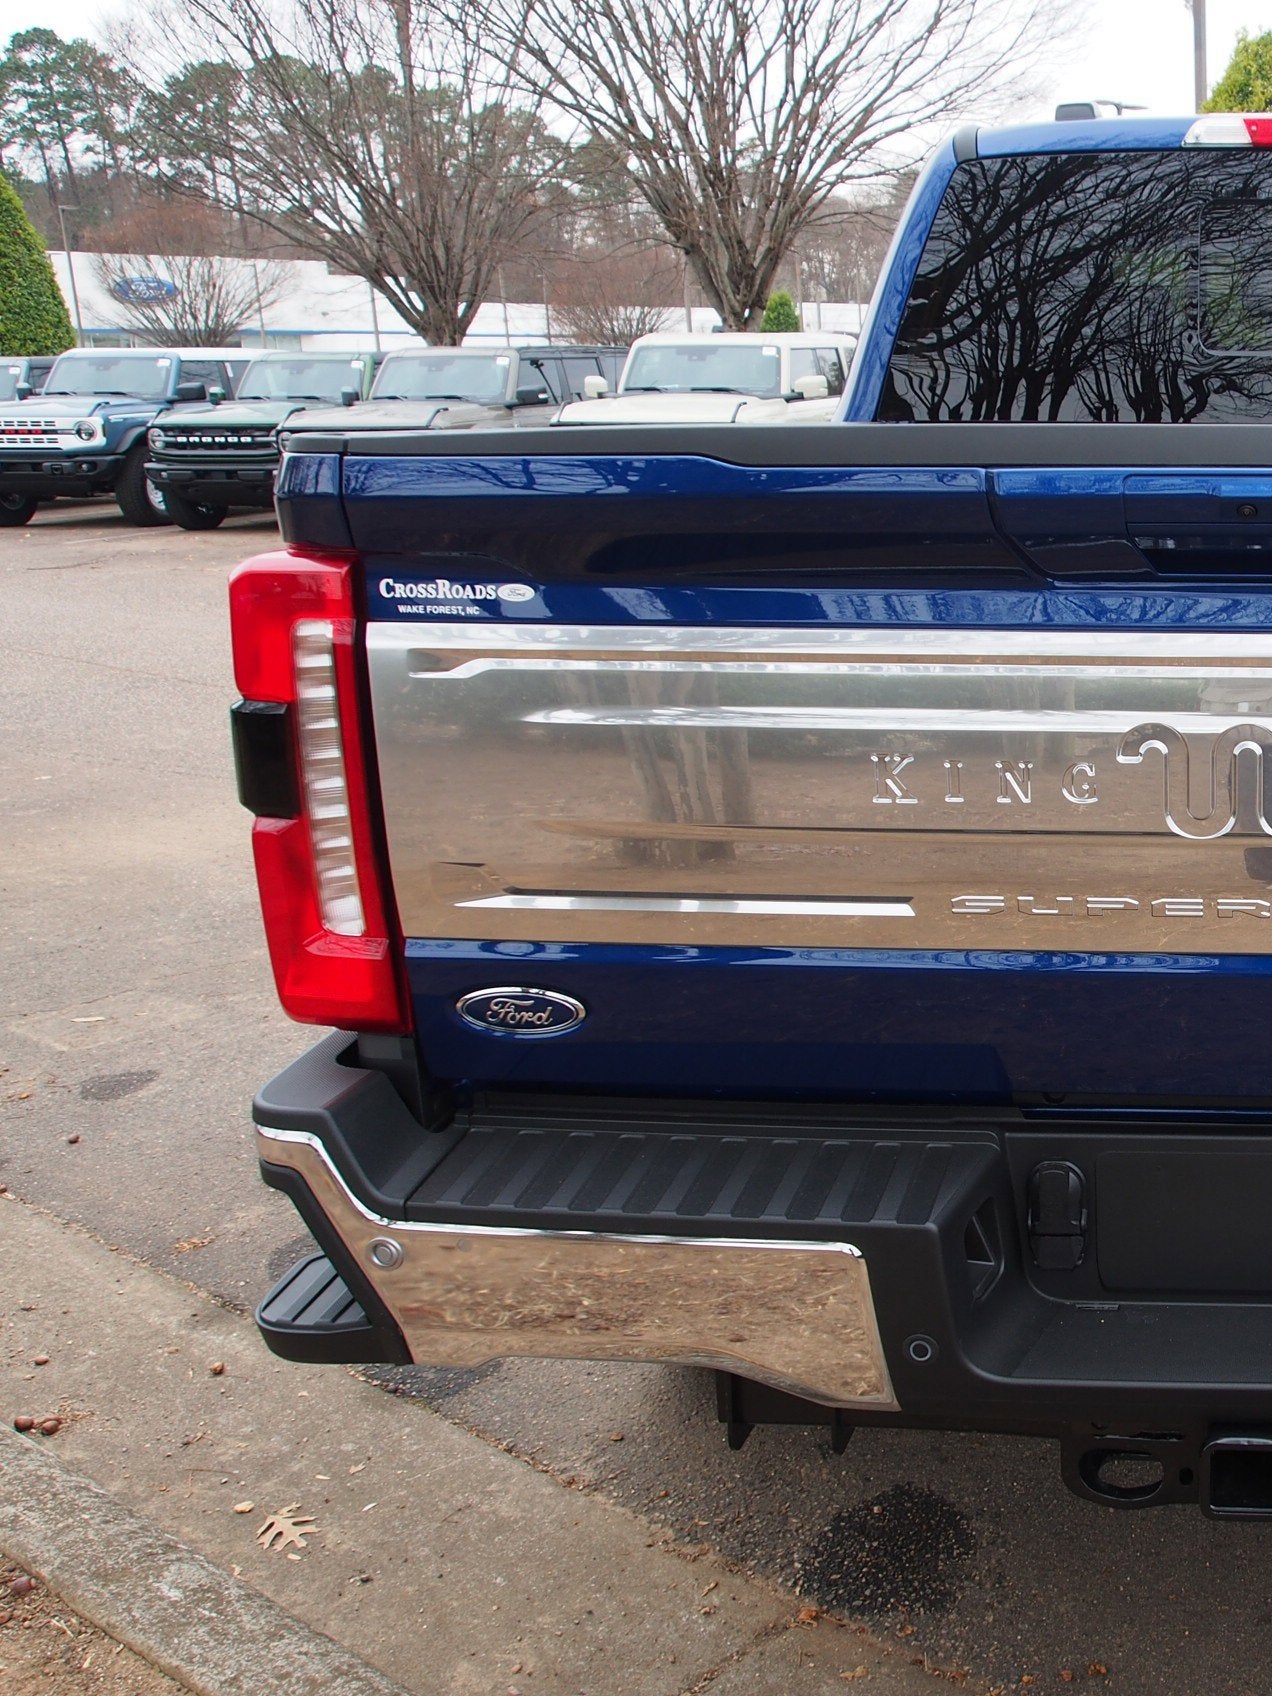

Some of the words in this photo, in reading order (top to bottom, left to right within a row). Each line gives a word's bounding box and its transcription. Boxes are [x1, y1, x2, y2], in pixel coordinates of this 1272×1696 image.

[397, 605, 425, 614] WAKE
[427, 605, 465, 616] FOREST,
[466, 607, 480, 615] NC
[870, 753, 1099, 804] KING
[951, 895, 1271, 918] SUPER
[486, 997, 553, 1025] Ford
